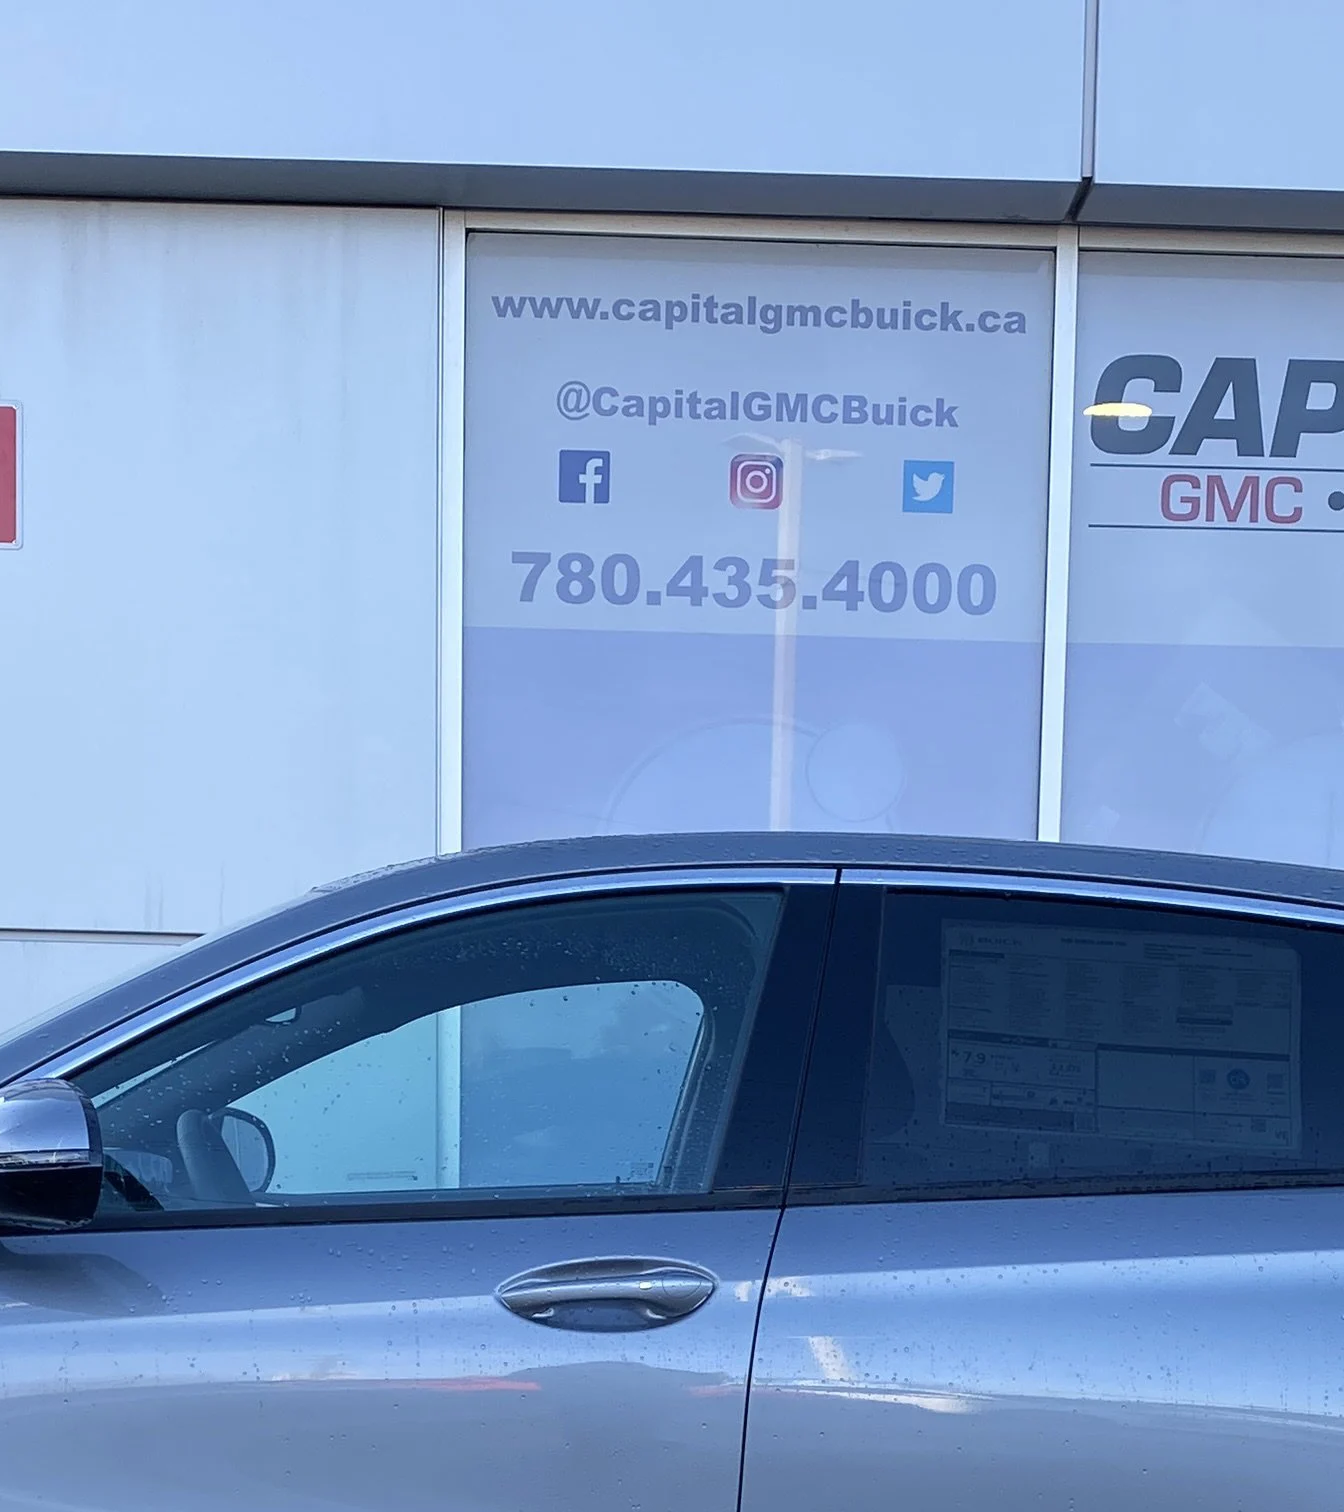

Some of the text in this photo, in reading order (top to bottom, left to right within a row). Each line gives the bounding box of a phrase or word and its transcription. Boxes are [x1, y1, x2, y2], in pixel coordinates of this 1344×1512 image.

[492, 292, 1027, 334] www.capitalgmcbuick.ca
[556, 381, 959, 429] @CapitalGMCBuick
[1160, 474, 1304, 525] GMC
[510, 551, 997, 616] 780.435.4000
